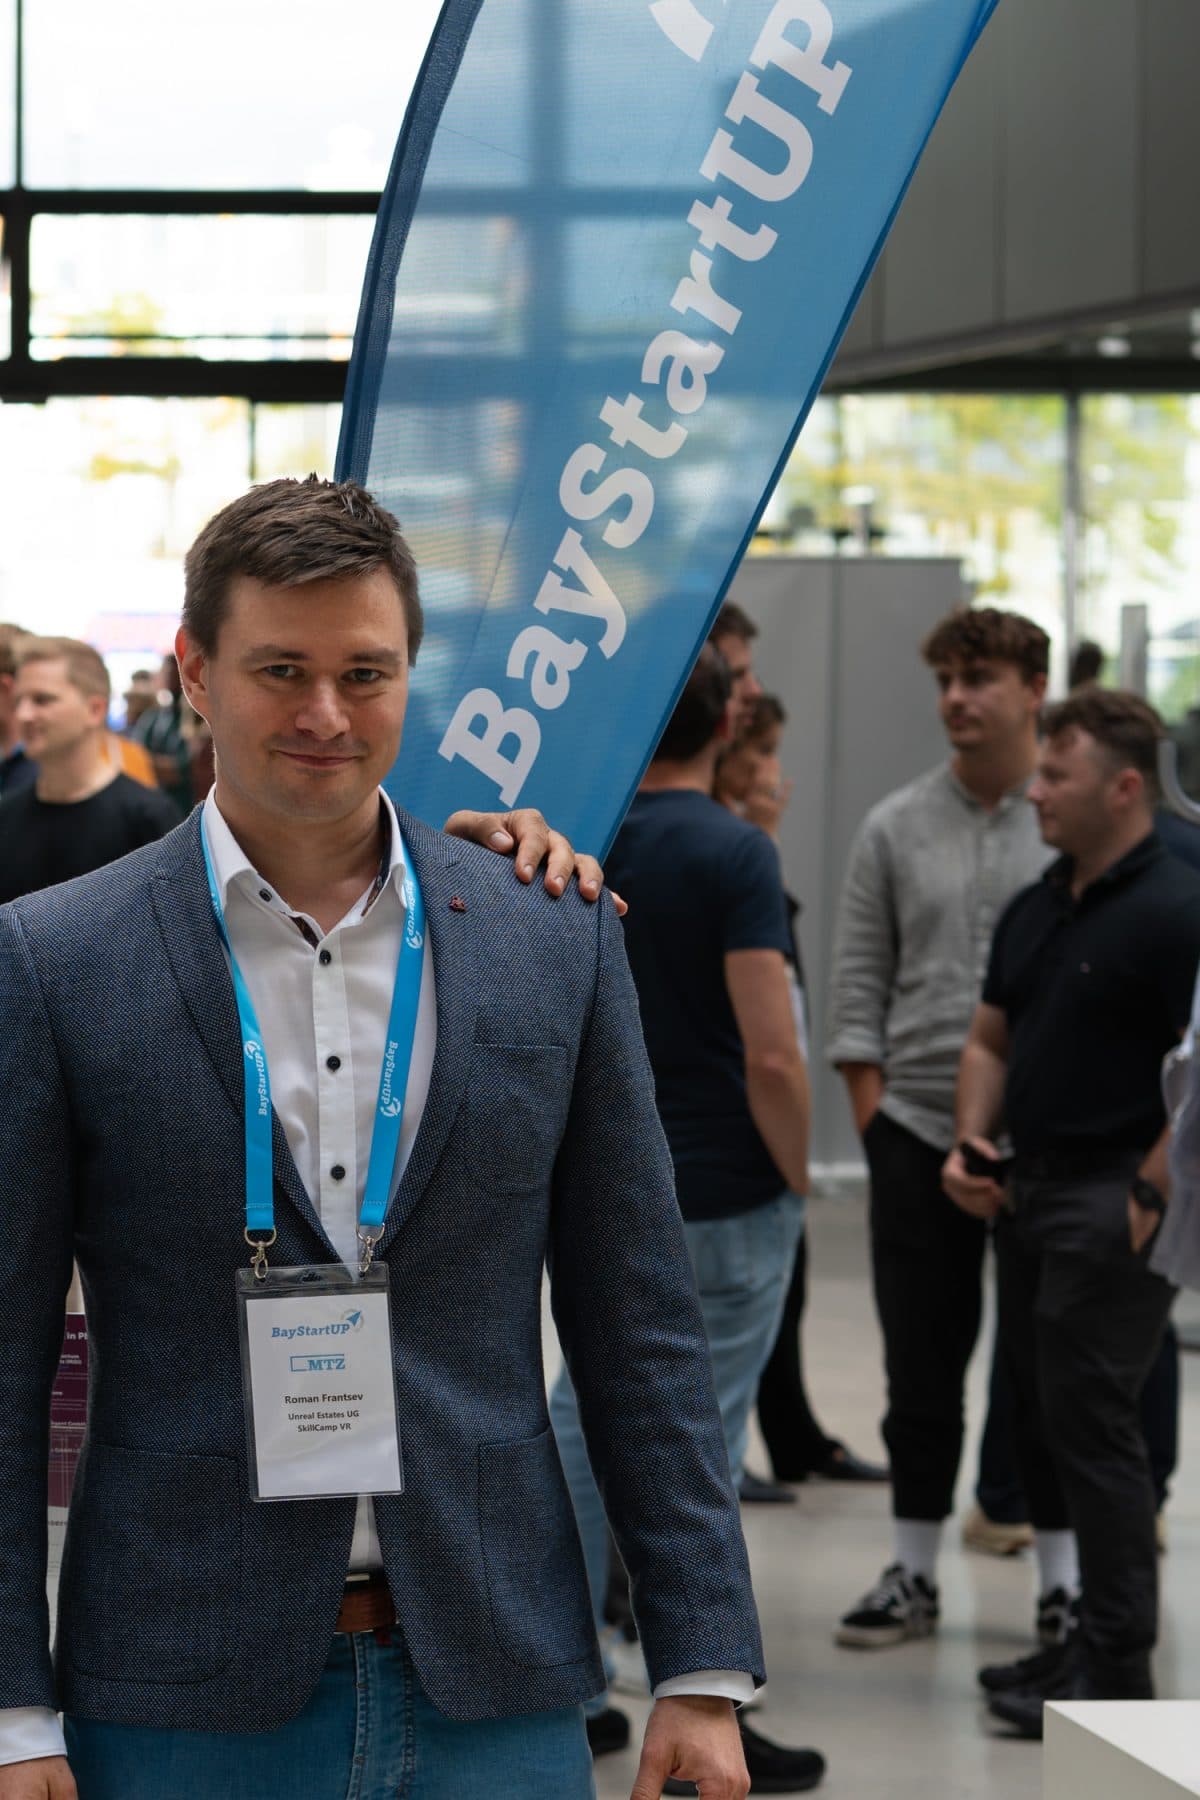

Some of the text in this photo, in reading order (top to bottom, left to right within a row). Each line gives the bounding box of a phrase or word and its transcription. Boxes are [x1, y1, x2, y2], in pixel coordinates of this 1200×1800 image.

[437, 0, 853, 807] BayStartUP
[381, 1040, 399, 1105] BayStartUP
[254, 1052, 270, 1116] BayStartUP
[271, 1324, 350, 1339] BayStartUP
[307, 1359, 345, 1371] MTZ
[284, 1393, 364, 1404] Roman Frantsev
[288, 1410, 360, 1421] Unreal Estates UG
[298, 1422, 352, 1434] SkillCamp VR
